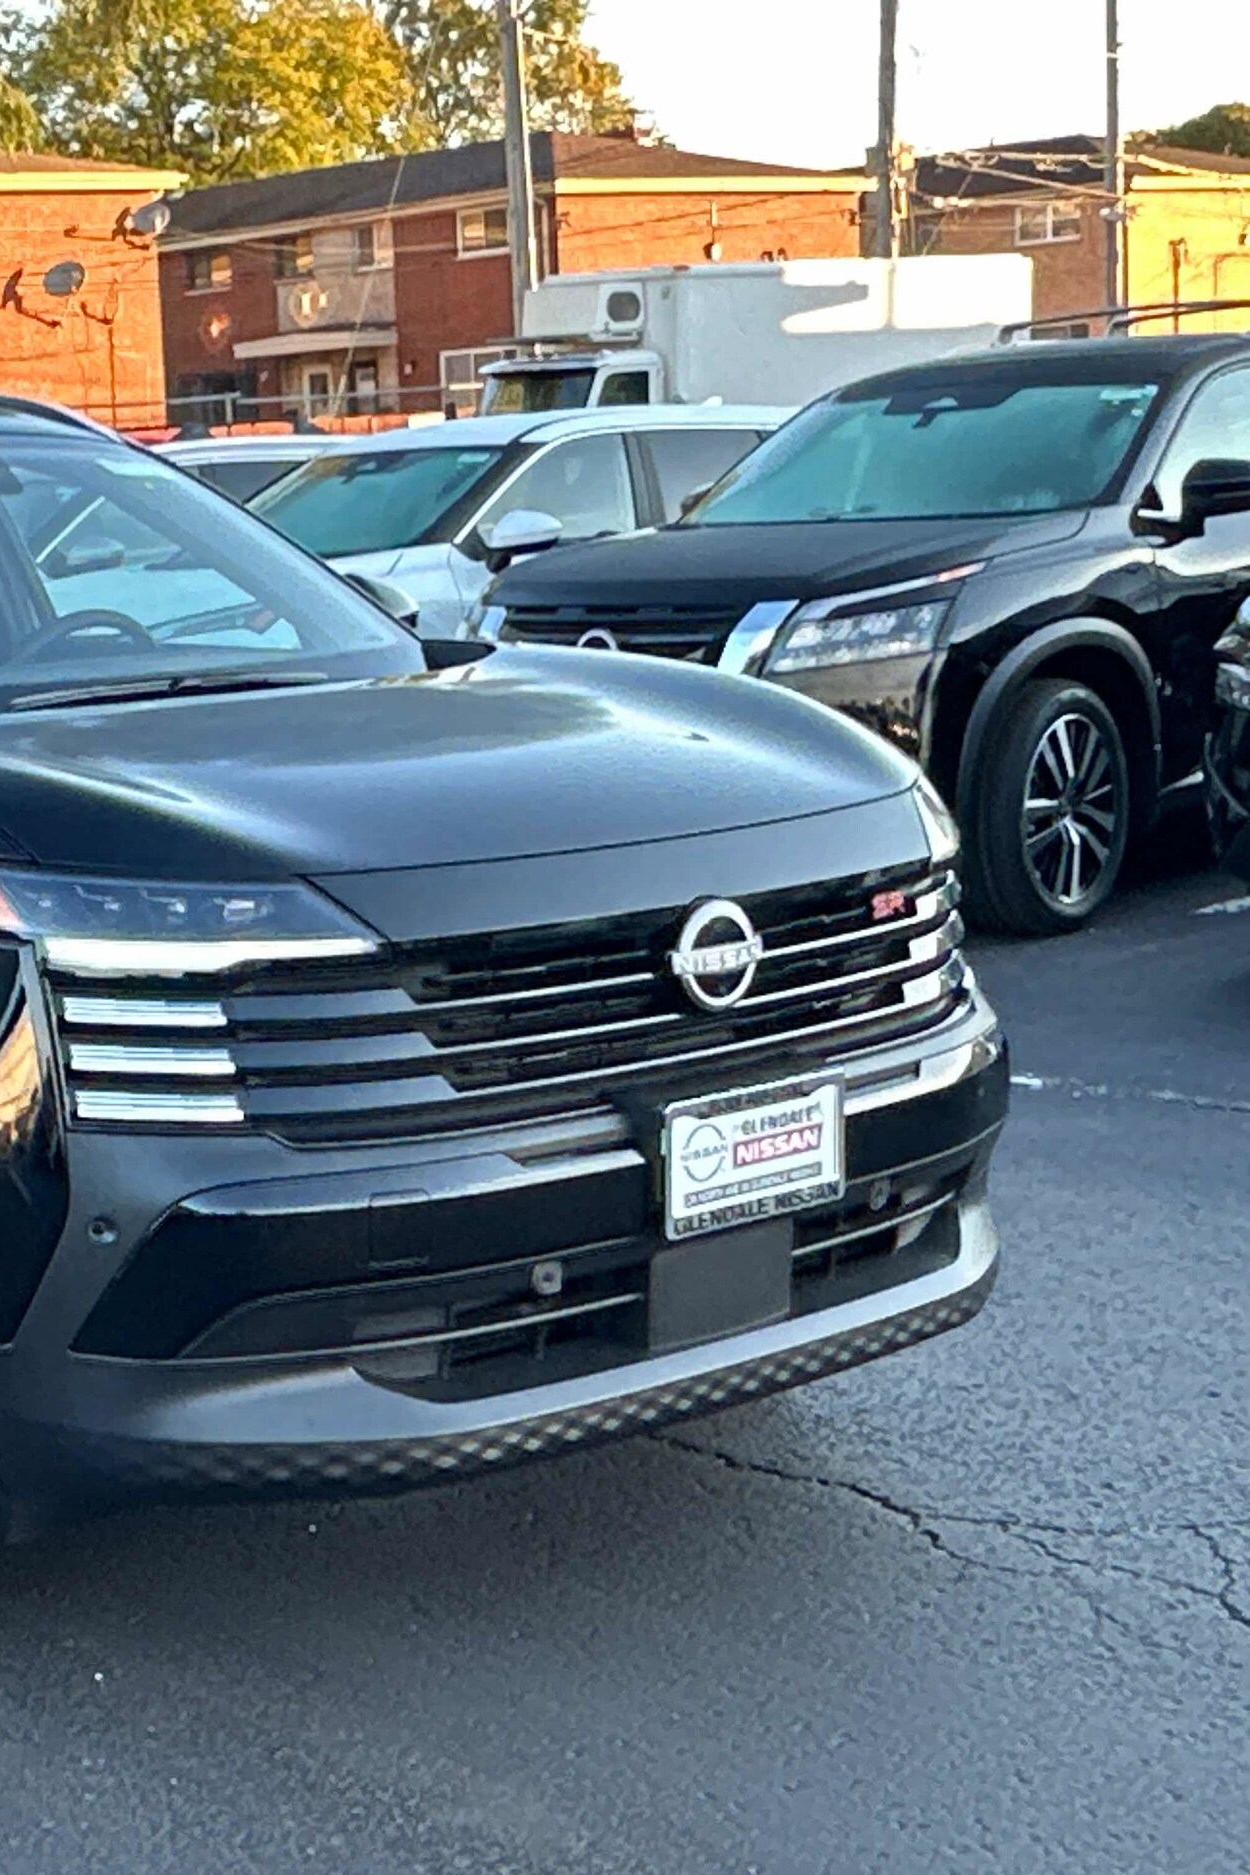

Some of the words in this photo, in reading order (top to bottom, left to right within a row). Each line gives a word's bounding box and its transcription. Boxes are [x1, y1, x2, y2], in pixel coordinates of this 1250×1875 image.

[673, 938, 762, 975] NISSAN
[740, 1106, 814, 1135] GLENDALE
[680, 1143, 729, 1161] NISSAN
[736, 1129, 819, 1164] NISSAN
[674, 1198, 769, 1235] GLENDALE
[775, 1182, 840, 1210] NISSAN
